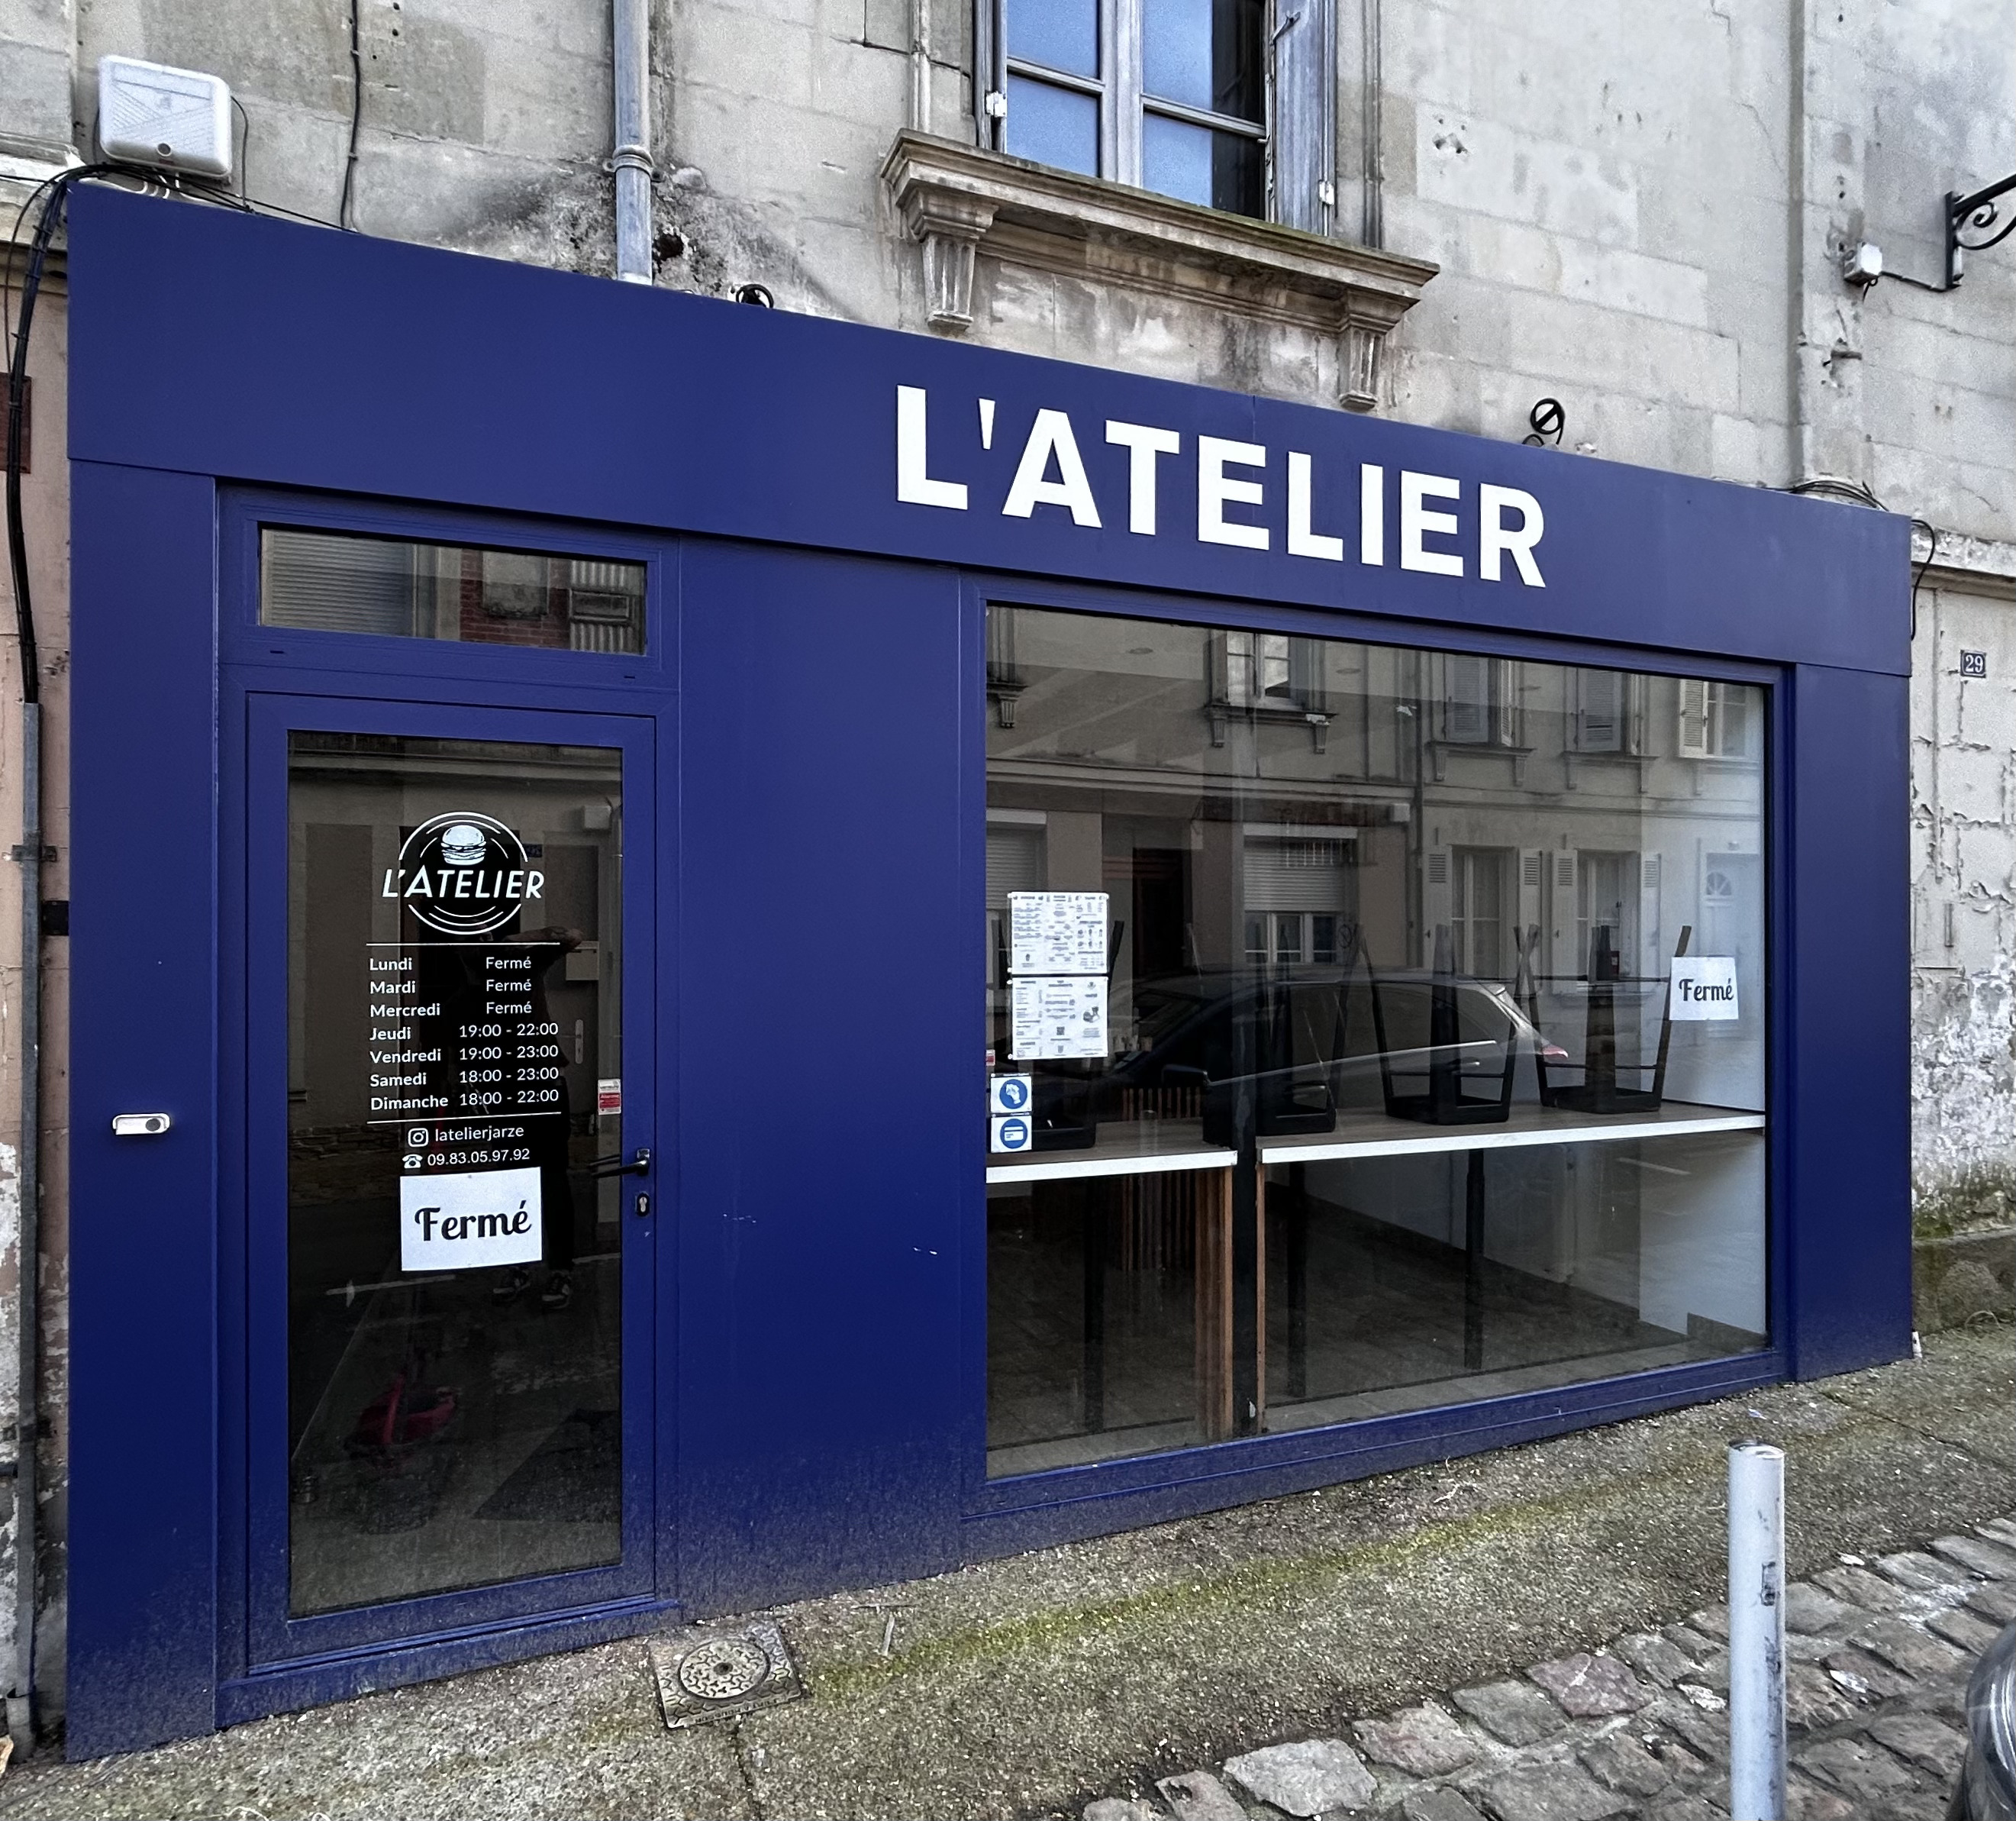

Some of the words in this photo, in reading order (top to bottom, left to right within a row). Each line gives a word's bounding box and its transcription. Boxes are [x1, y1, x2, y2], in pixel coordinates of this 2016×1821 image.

[897, 384, 1546, 588] L'ATELIER
[1965, 654, 1984, 673] 29
[382, 865, 544, 899] L'ATELIER
[369, 957, 412, 970] Lundi
[485, 956, 532, 970] Fermé
[369, 980, 416, 995] Mardi
[486, 978, 532, 992] Fermé
[1679, 977, 1734, 1002] Fermé
[370, 1003, 440, 1018] Mercredi
[486, 1000, 532, 1015] Fermé
[369, 1026, 411, 1041] Jeudi
[459, 1024, 502, 1038] 19:00
[517, 1022, 559, 1036] 22:00
[369, 1048, 441, 1064] Vendredi
[460, 1046, 502, 1061] 19:00
[516, 1044, 559, 1058] 23:00
[369, 1072, 427, 1087] Samedi
[459, 1069, 502, 1083] 18:00
[517, 1067, 559, 1081] 23:00
[371, 1094, 449, 1111] Dimanche
[460, 1092, 502, 1106] 18:00
[517, 1089, 559, 1103] 22:00
[435, 1125, 524, 1143] latelierjarze
[427, 1148, 531, 1167] 09.83.05.97.92
[414, 1199, 532, 1241] Fermé
